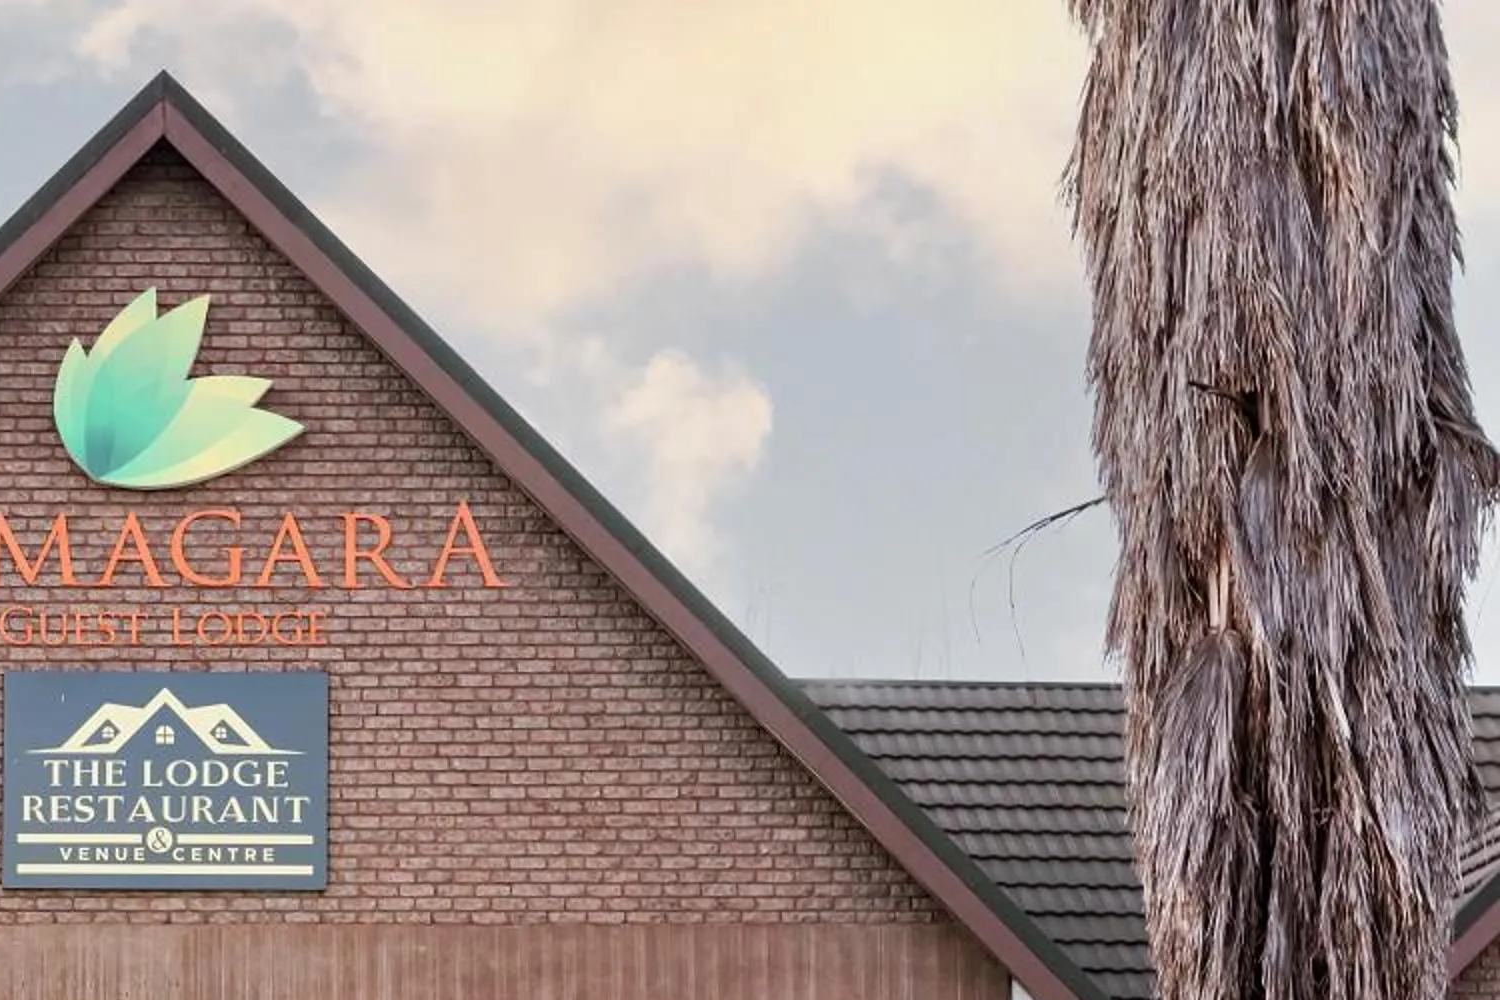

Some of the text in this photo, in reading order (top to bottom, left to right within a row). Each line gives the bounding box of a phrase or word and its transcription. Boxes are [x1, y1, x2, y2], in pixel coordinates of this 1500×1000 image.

[170, 606, 328, 646] LODGE
[43, 759, 290, 789] THE LODGE
[21, 795, 311, 825] RESTAURANT
[59, 828, 277, 863] VENUE & CENTRE
